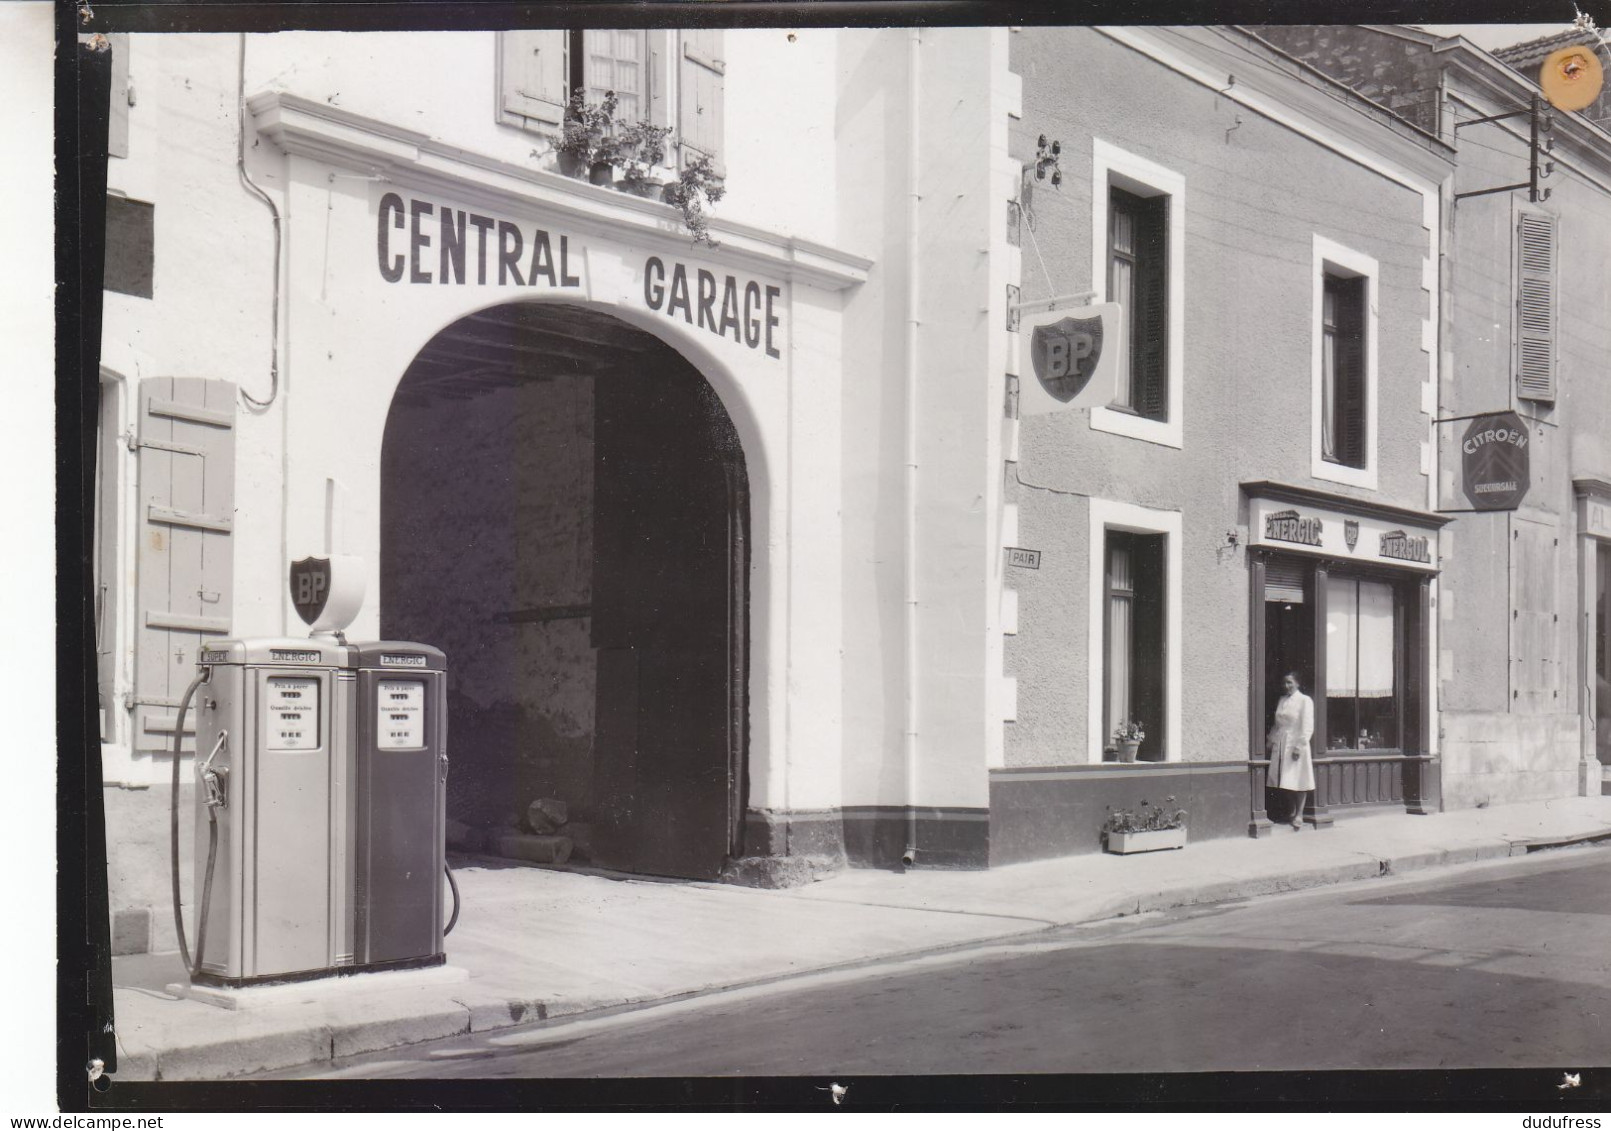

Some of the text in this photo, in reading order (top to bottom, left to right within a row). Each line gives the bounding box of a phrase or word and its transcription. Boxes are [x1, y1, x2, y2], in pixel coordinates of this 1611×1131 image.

[377, 192, 781, 360] CENTRAL GARAGE
[1042, 332, 1093, 380] BP
[1463, 428, 1528, 454] CITROËN
[1474, 481, 1518, 494] SUCCURSALE
[1264, 511, 1323, 547] ENERGIC
[1346, 526, 1357, 545] BP
[1013, 552, 1035, 565] PAIR
[297, 571, 326, 605] BP
[207, 652, 227, 662] SUPER
[271, 652, 316, 662] ENERGIC
[383, 656, 423, 665] ENERGIC
